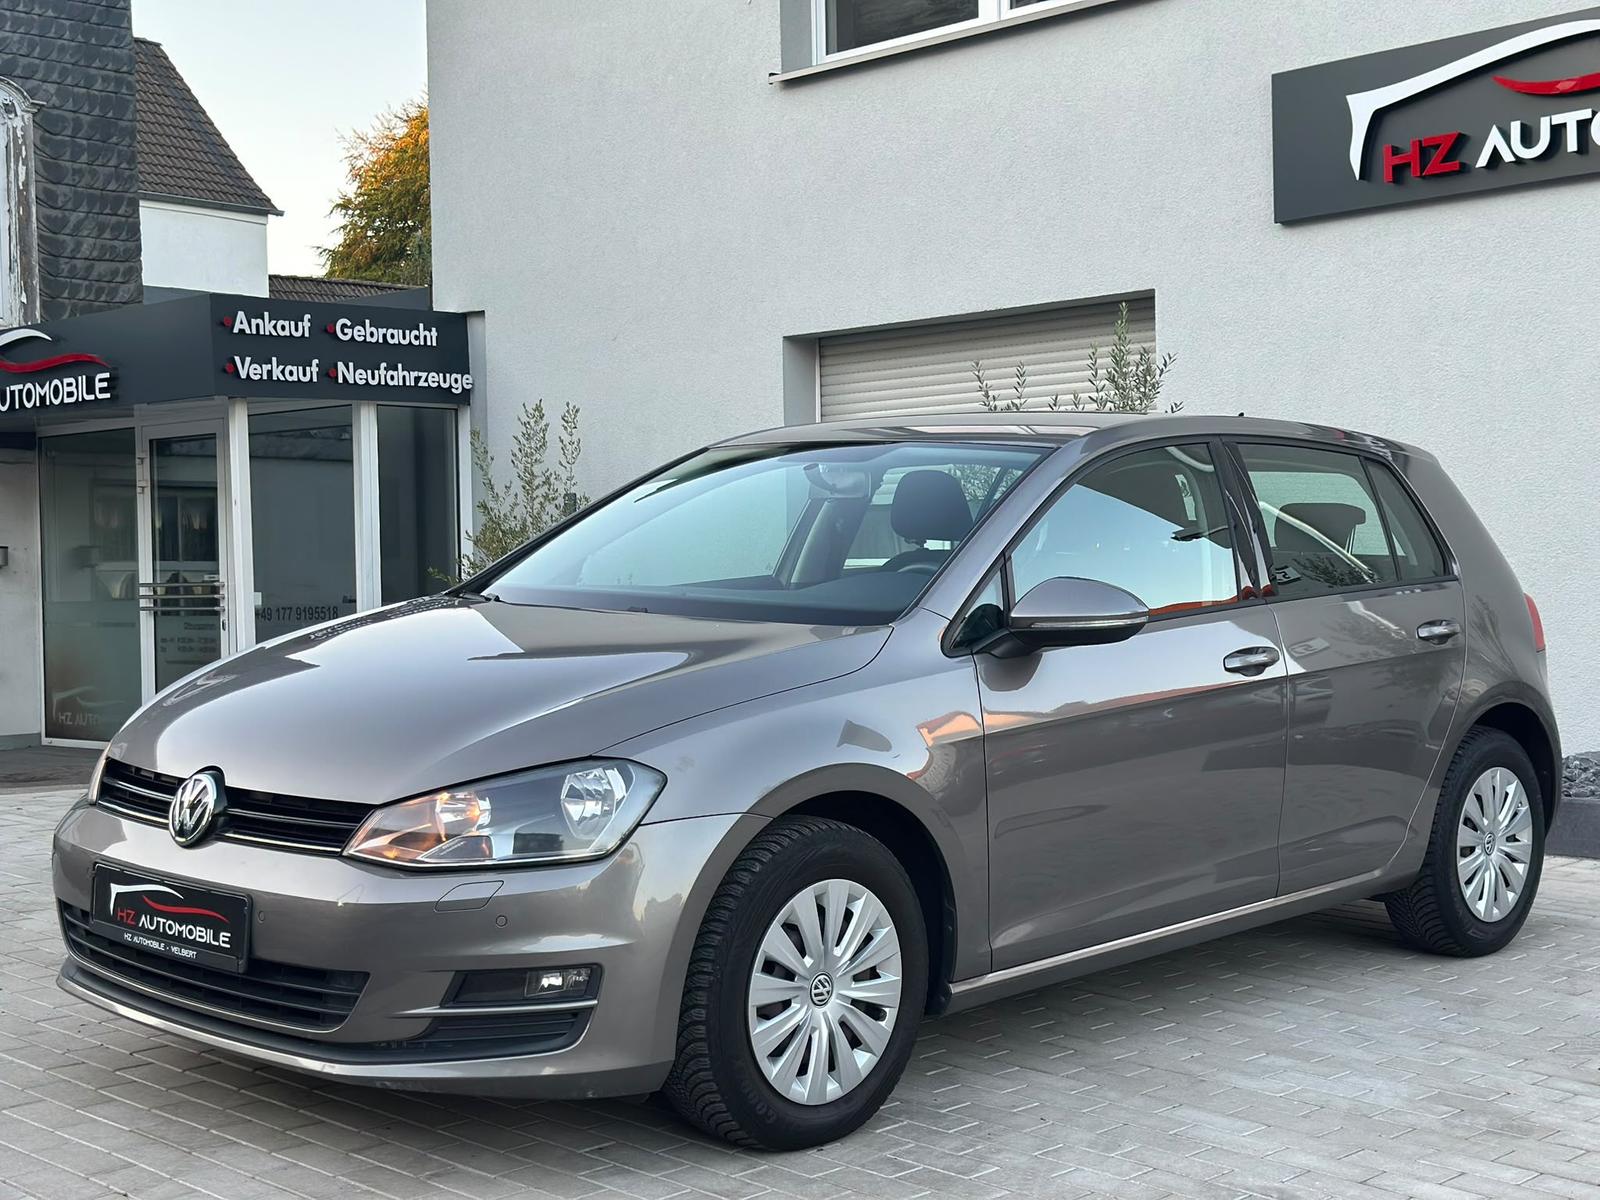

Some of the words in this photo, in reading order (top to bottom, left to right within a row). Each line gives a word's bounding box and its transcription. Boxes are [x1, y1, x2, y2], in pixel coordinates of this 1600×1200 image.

[1383, 131, 1462, 183] HZ
[1475, 108, 1600, 168] AUT
[233, 311, 311, 337] Ankauf
[336, 318, 438, 346] Gebraucht
[233, 356, 319, 382] Verkauf
[337, 361, 473, 394] Neufahrzeuge
[276, 606, 295, 620] 177
[296, 606, 338, 620] 9195518
[117, 907, 136, 926] HZ
[139, 914, 231, 948] AUTOMOBILE
[124, 932, 132, 942] HZ
[133, 936, 165, 951] AUTOMOBILE
